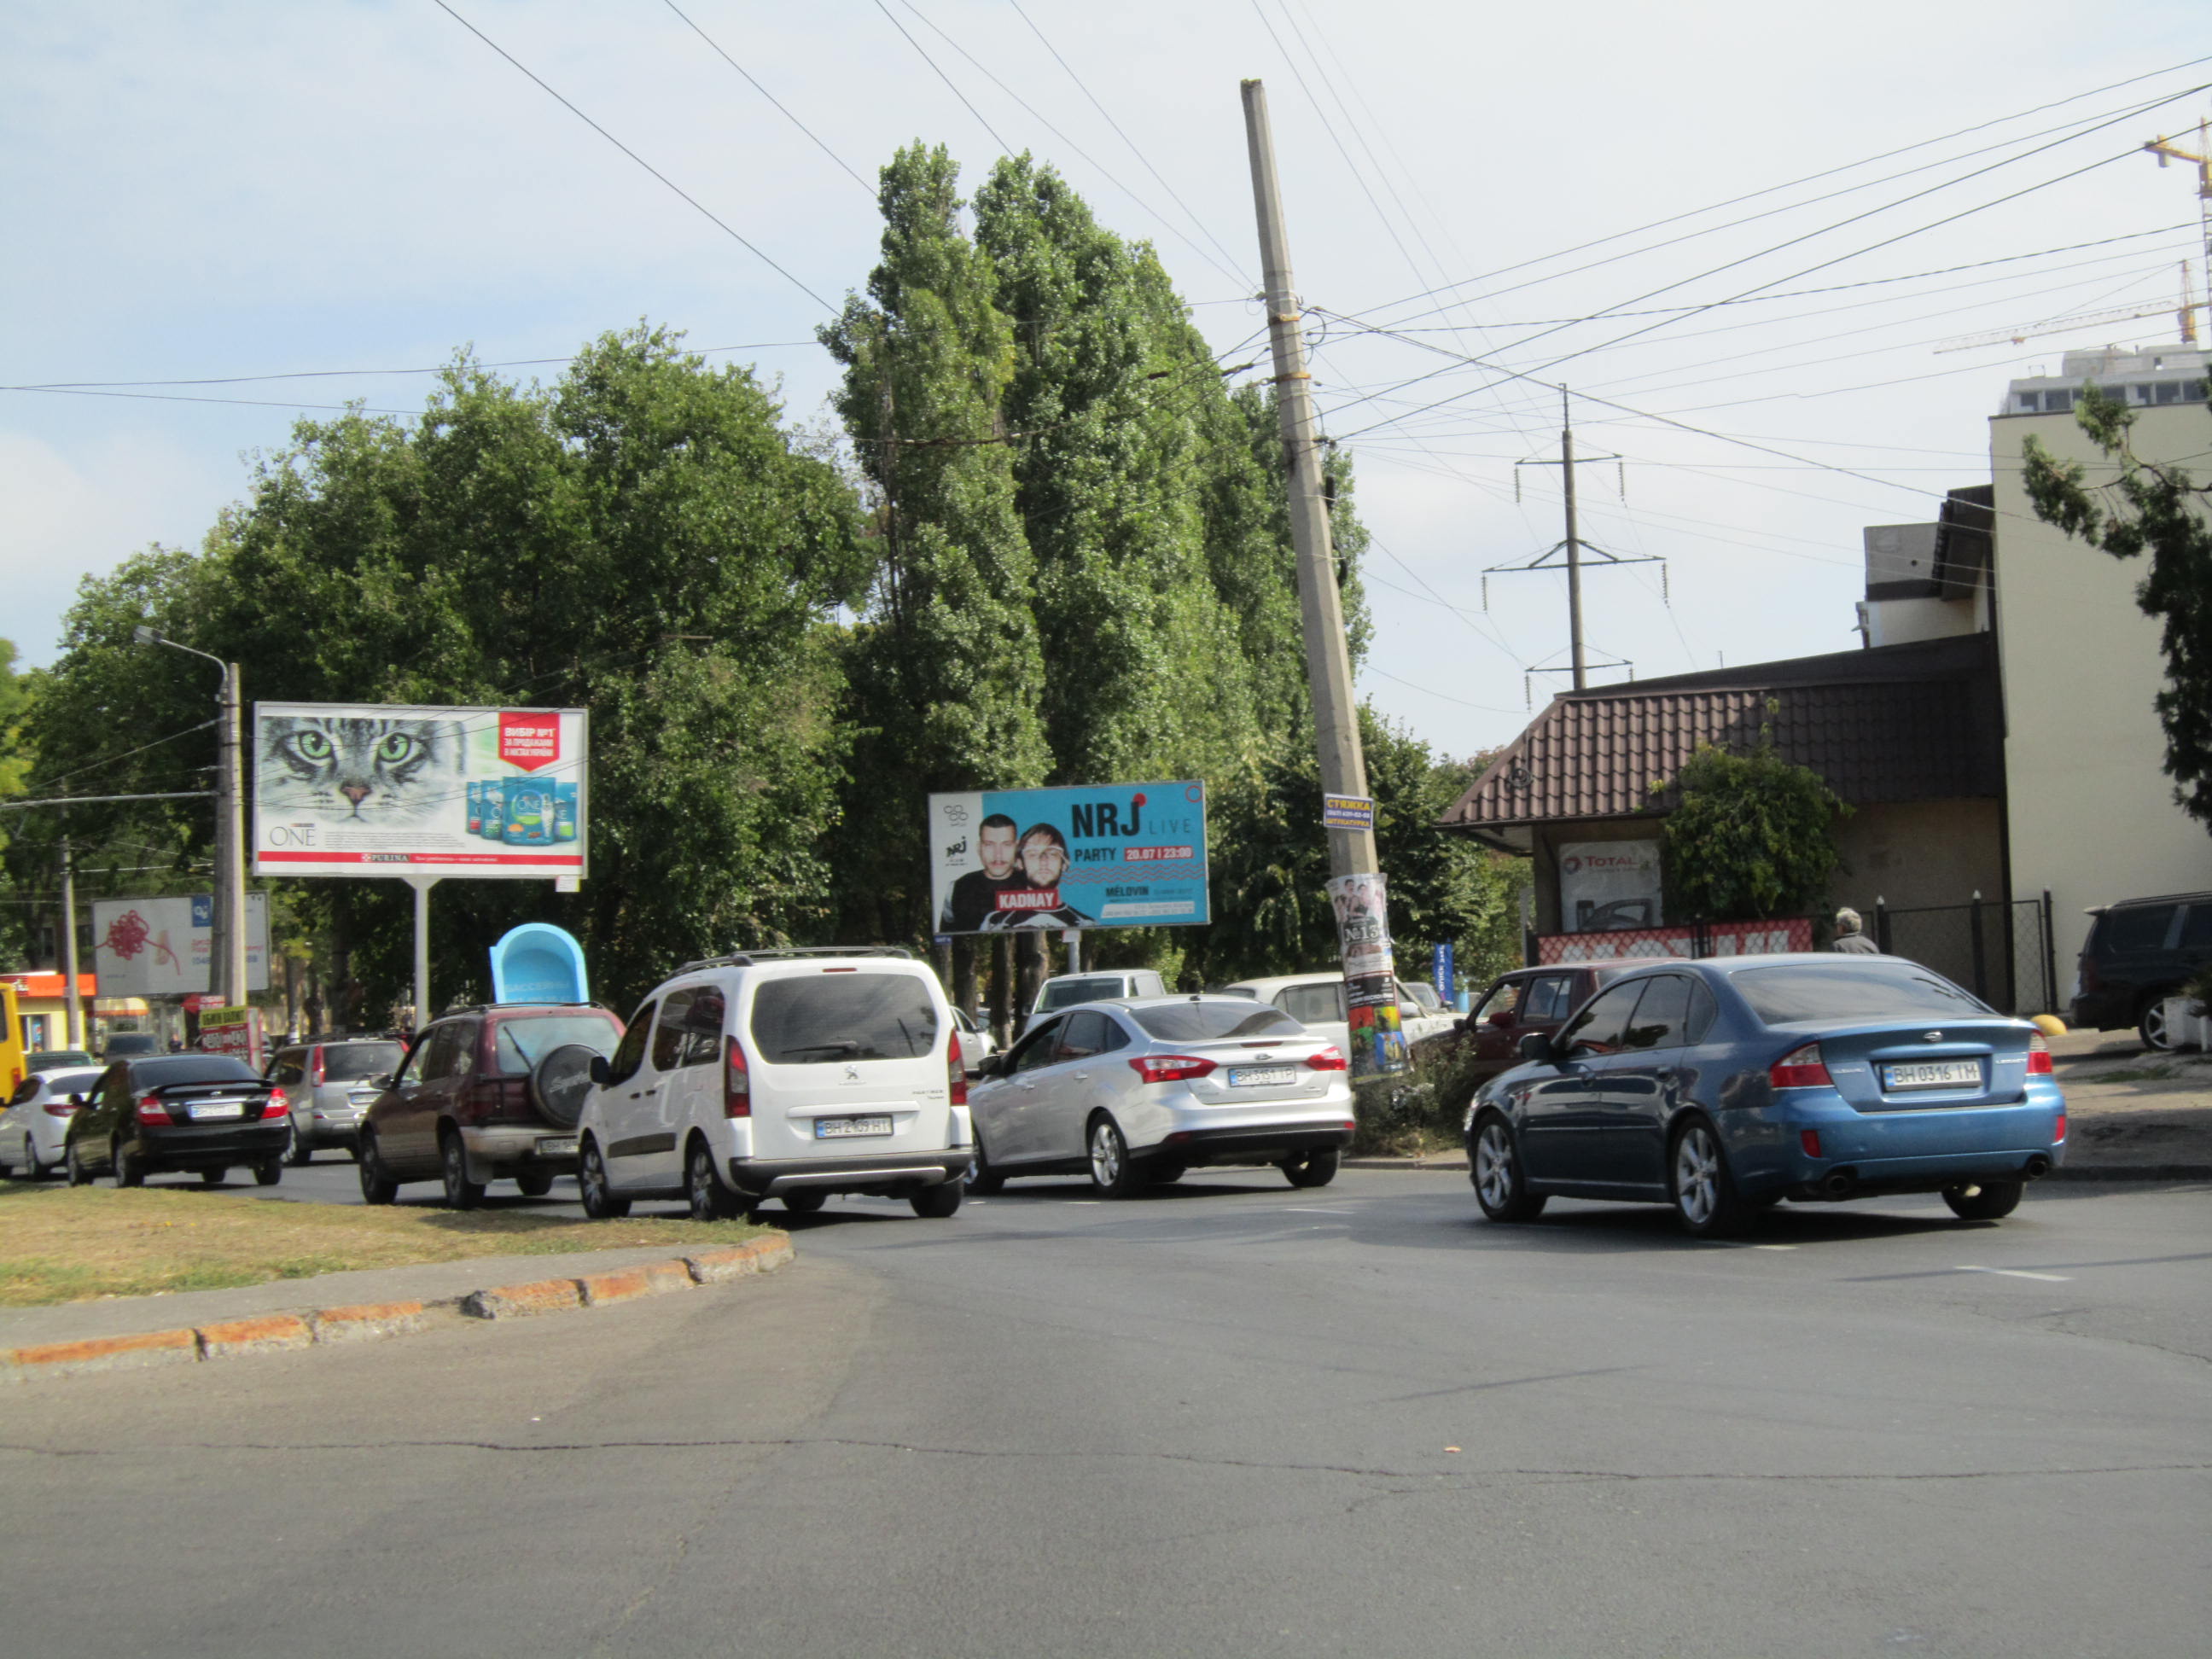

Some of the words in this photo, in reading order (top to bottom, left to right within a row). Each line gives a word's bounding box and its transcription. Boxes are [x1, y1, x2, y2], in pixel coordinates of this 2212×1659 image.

[504, 727, 535, 737] ВИБІР
[1072, 801, 1140, 838] NRJ
[1149, 819, 1191, 835] LIVE
[270, 826, 316, 847] ONE
[372, 853, 409, 862] PURINA
[1075, 847, 1117, 862] PARTY
[999, 893, 1055, 909] KADNAY
[1894, 1067, 1916, 1083] BH
[1918, 1064, 1952, 1081] 0316
